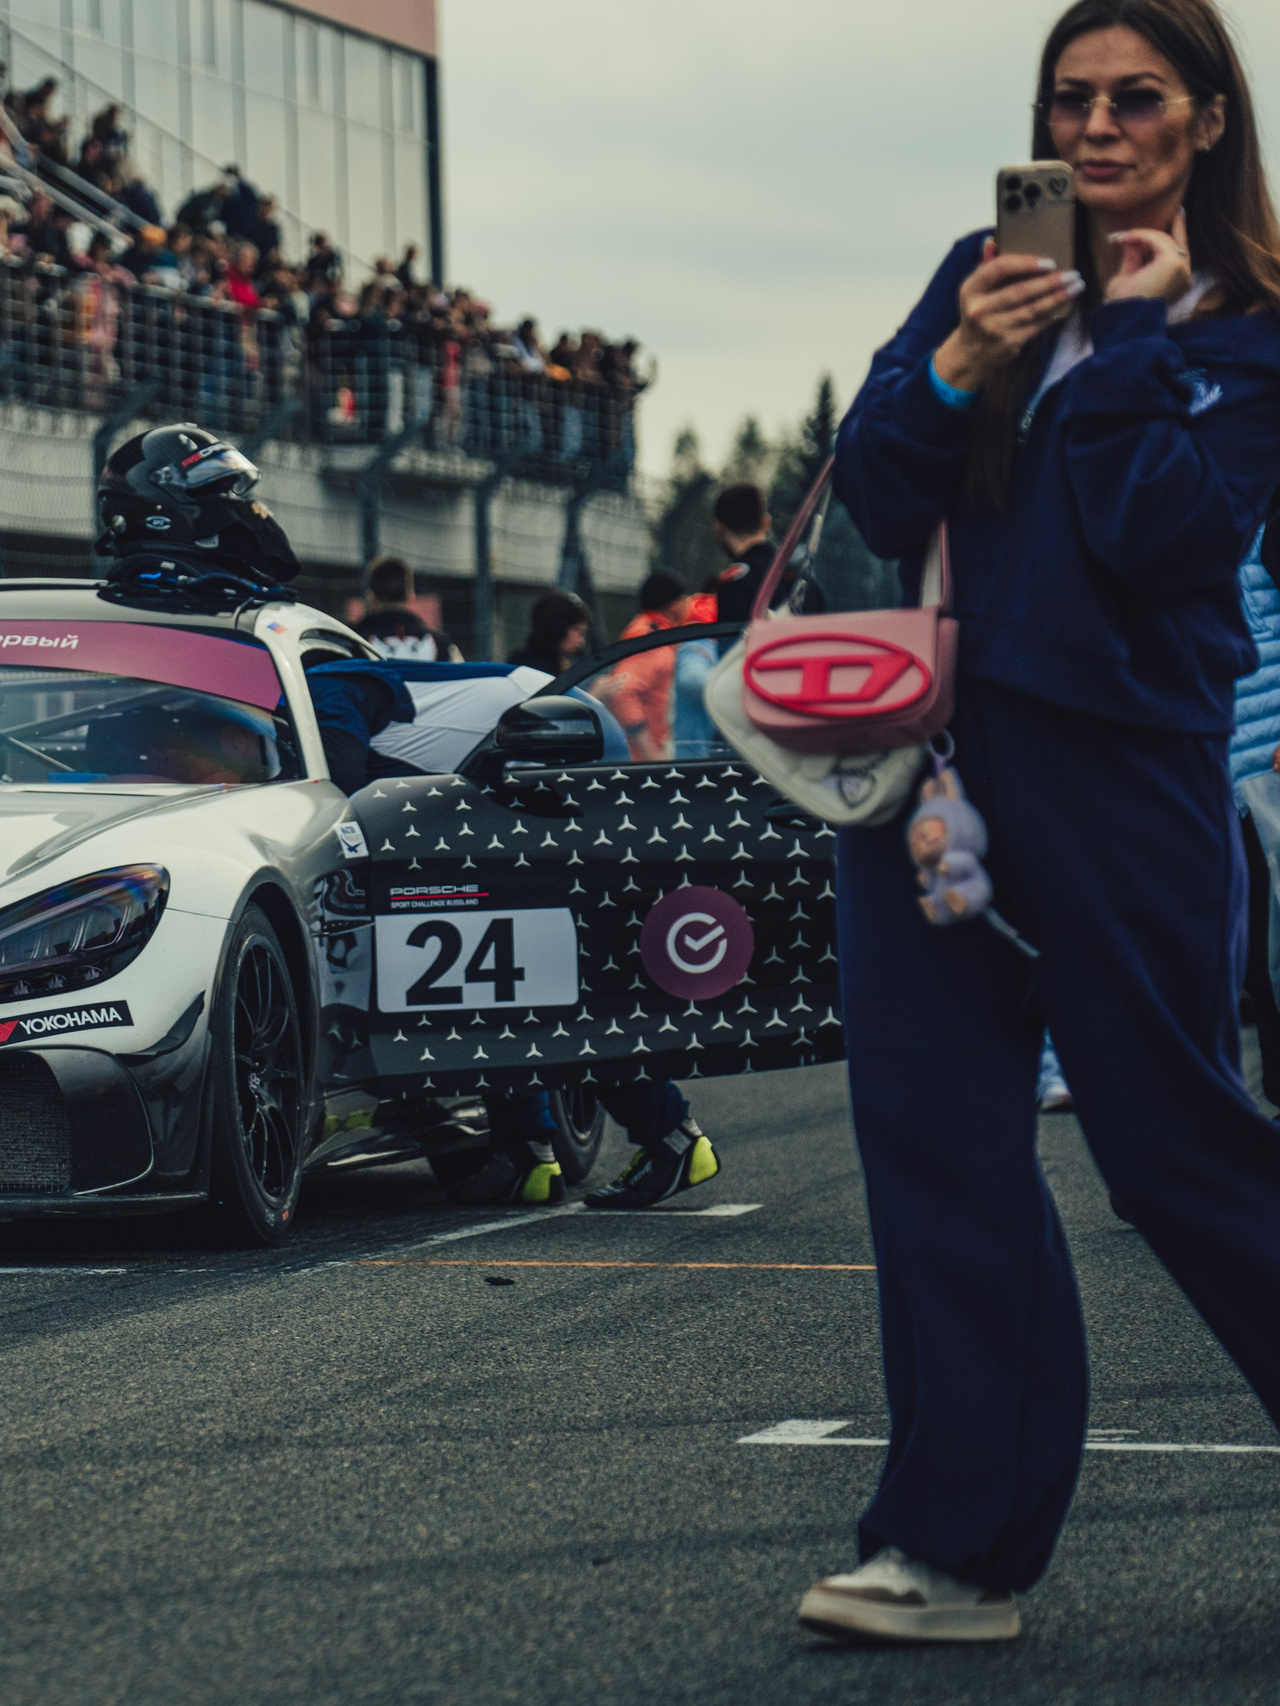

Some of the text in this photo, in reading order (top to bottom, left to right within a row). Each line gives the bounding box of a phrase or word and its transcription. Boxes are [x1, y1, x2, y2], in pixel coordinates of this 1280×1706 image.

[390, 884, 479, 896] PORSCHE
[391, 901, 410, 909] SPORT
[411, 899, 445, 908] CHALLENGE
[406, 917, 525, 1006] 24
[19, 1007, 123, 1035] YOKOHAMA
